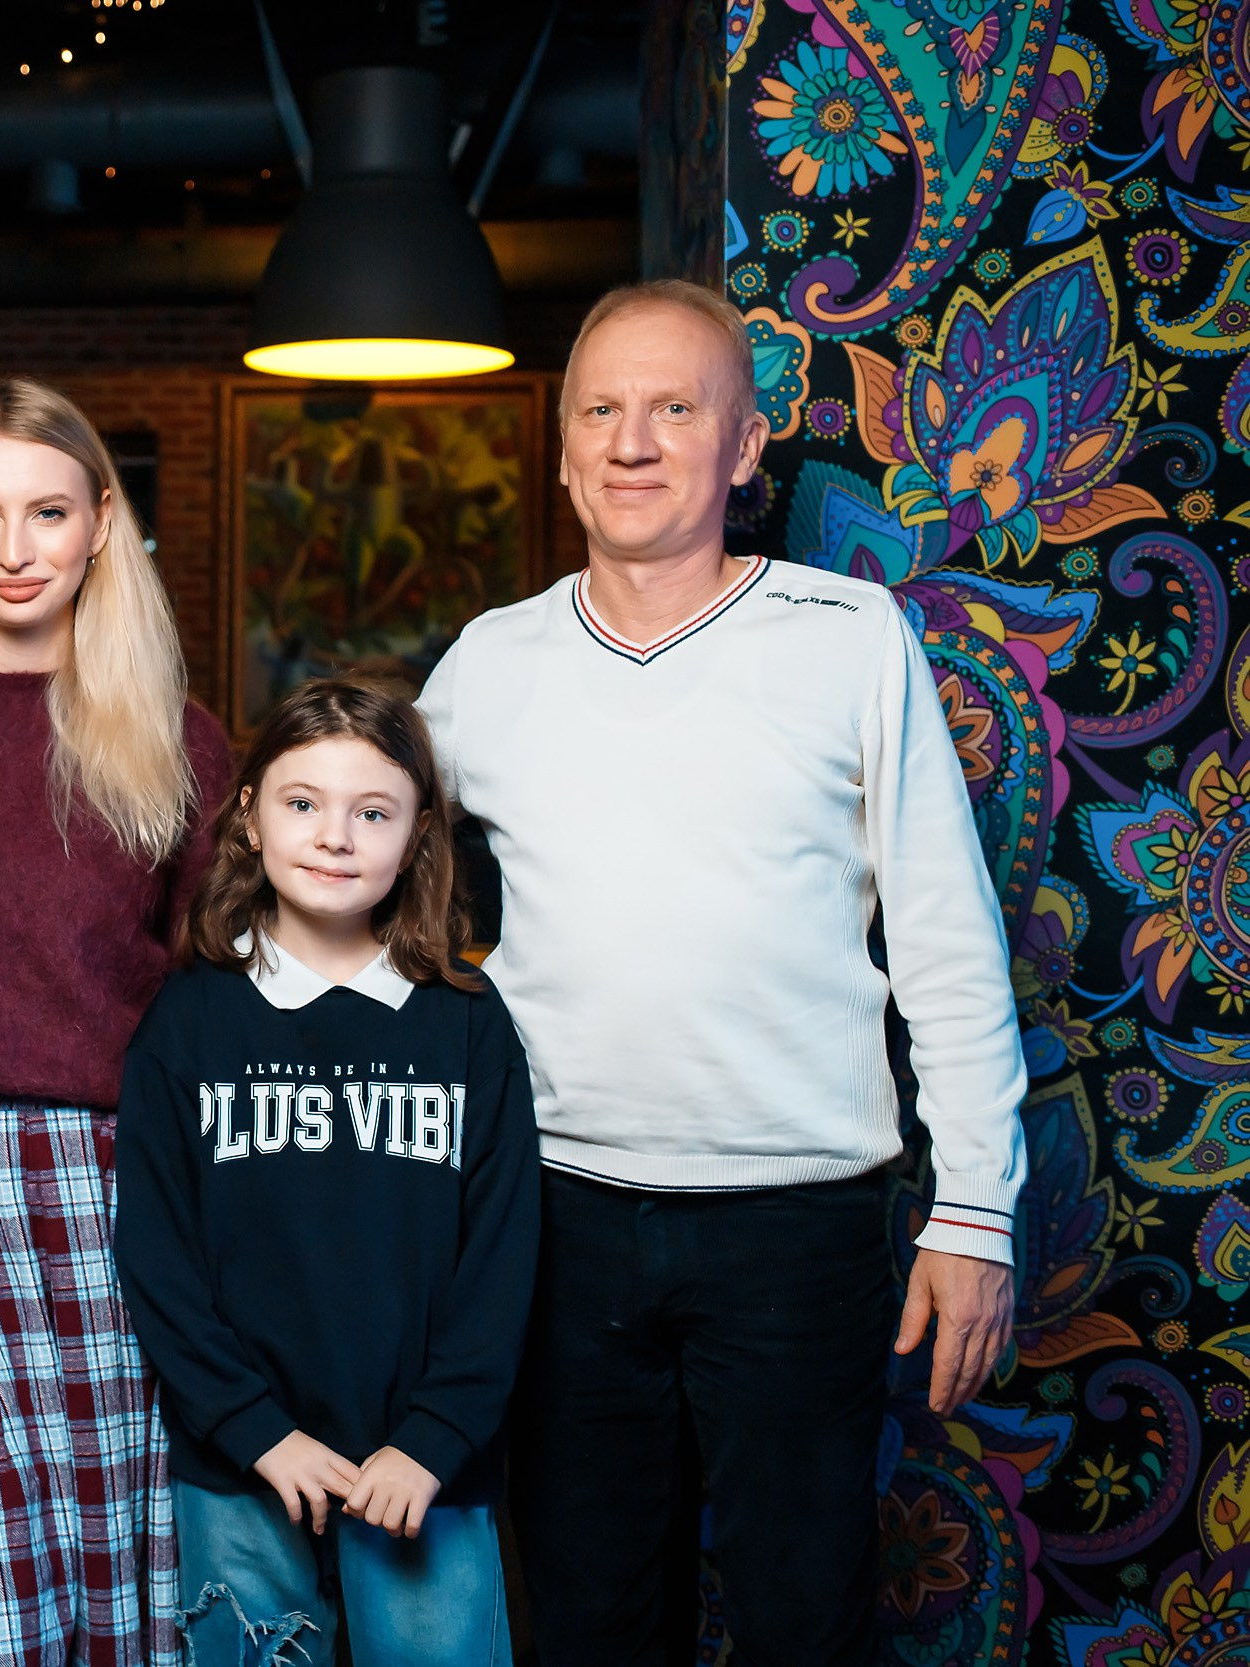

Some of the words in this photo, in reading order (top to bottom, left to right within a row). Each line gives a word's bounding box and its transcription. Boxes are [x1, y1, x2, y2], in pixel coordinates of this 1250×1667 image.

[245, 1063, 316, 1076] ALWAYS
[334, 1064, 354, 1076] BE
[370, 1062, 387, 1074] IN
[407, 1063, 415, 1075] A
